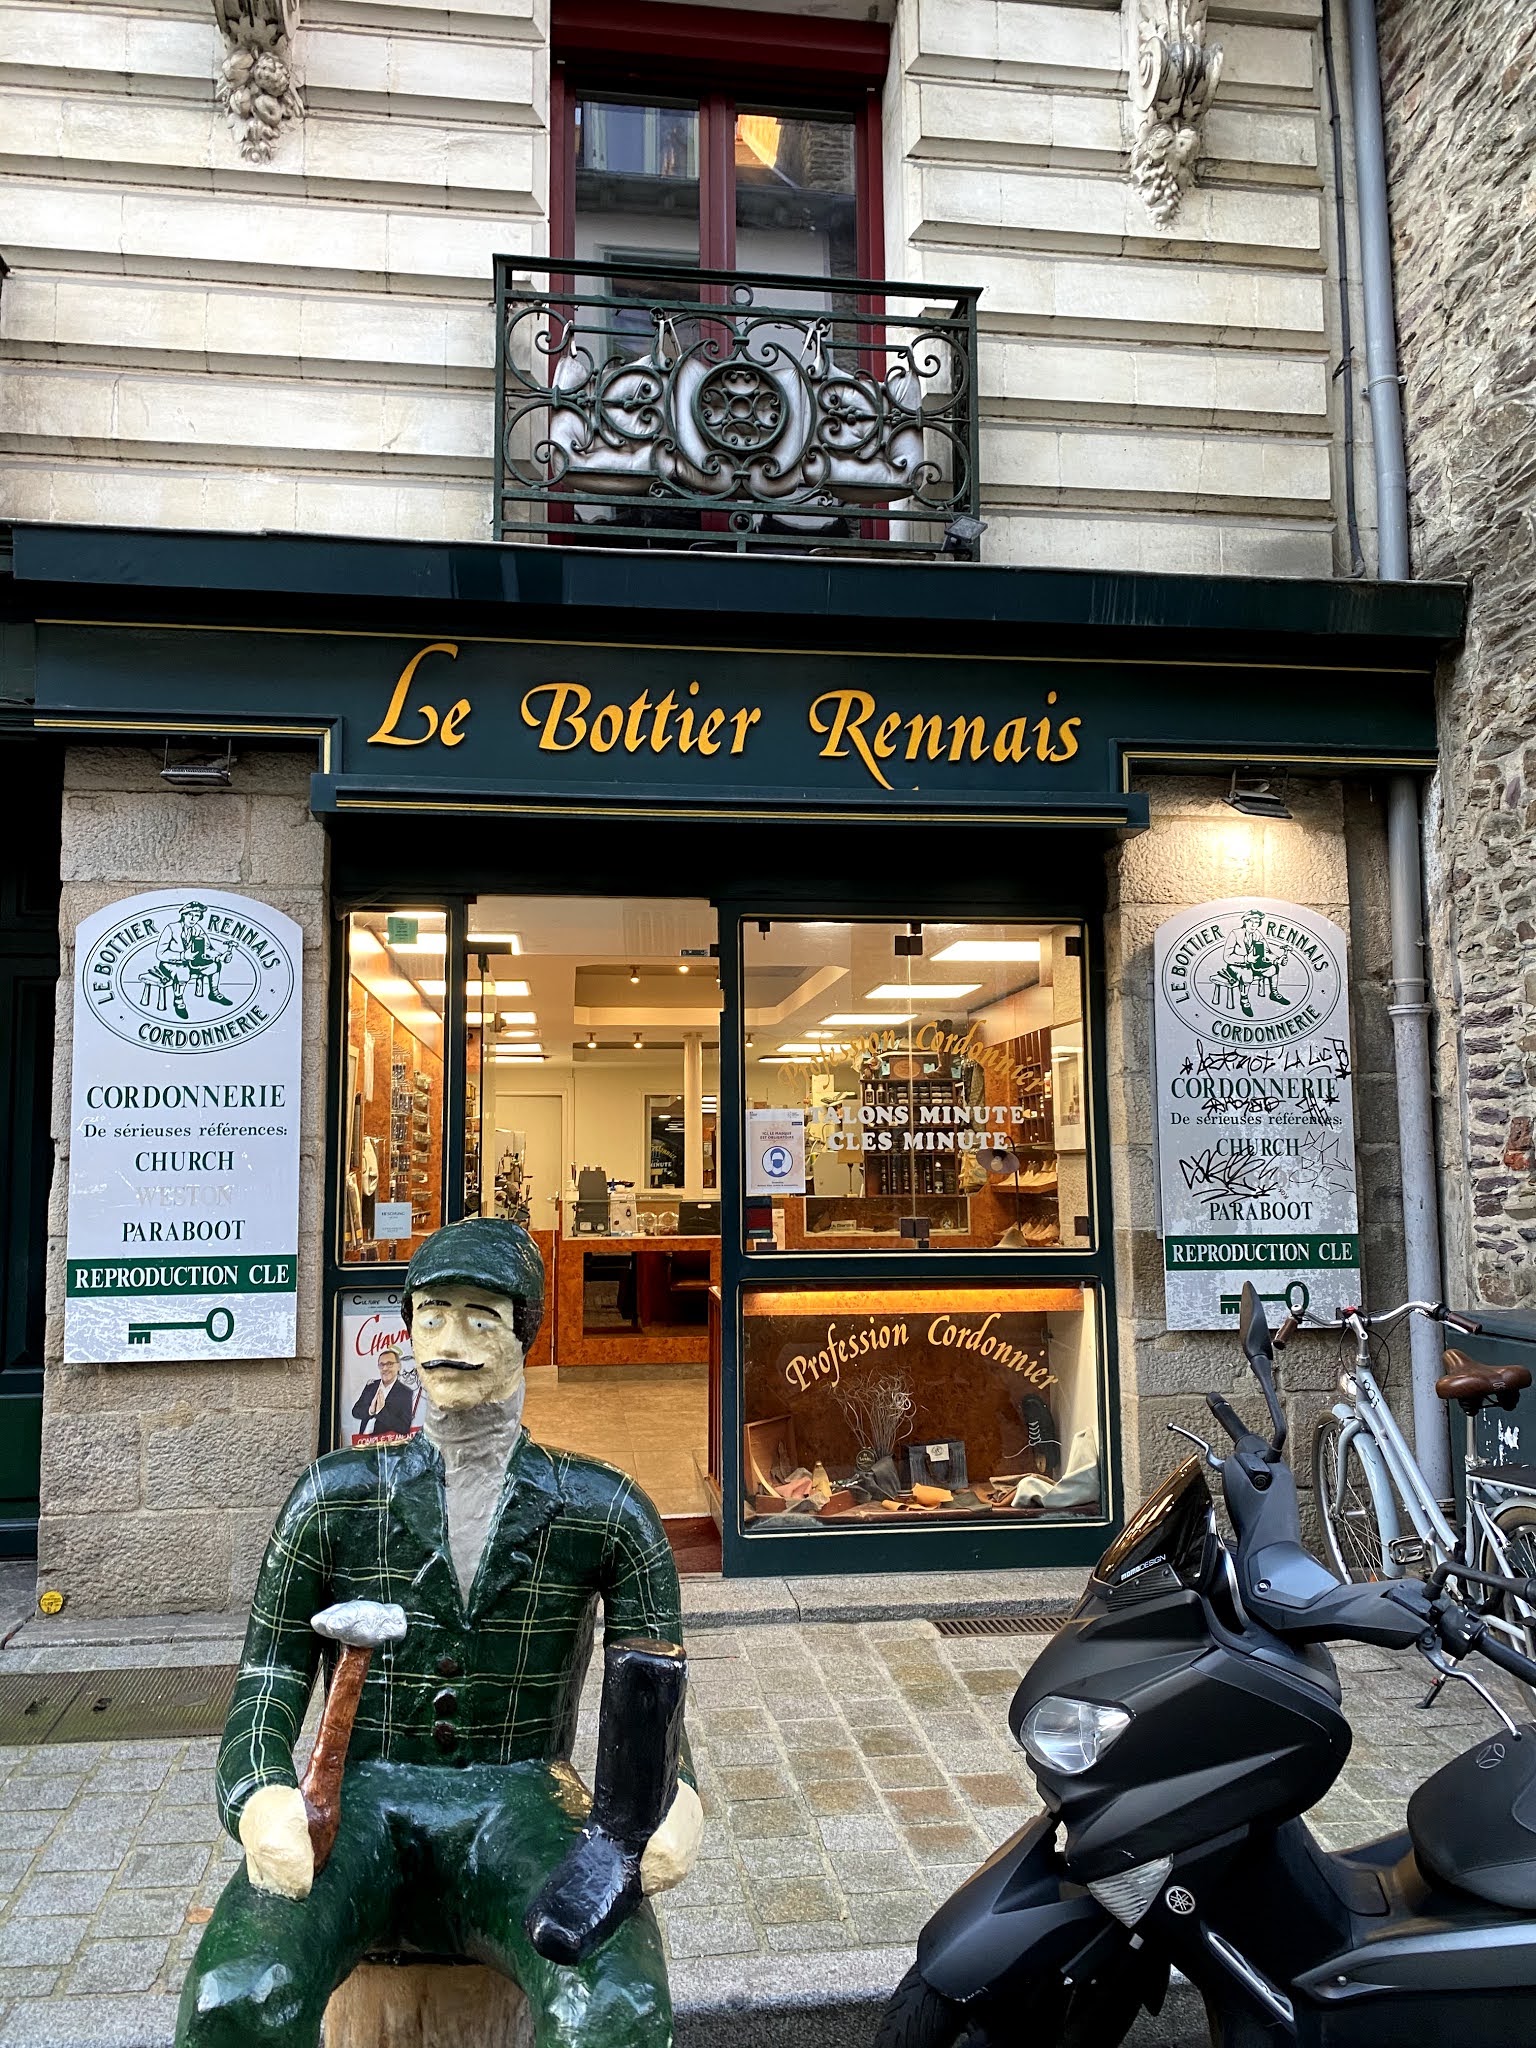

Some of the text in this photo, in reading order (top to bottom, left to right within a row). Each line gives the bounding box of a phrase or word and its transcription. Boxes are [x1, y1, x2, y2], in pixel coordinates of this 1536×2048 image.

[367, 643, 1082, 790] Le Bottier Rennais
[93, 914, 281, 1005] LE BOTTIER RENNAIS
[1171, 921, 1329, 1004] LE BOTTIER RENNAIS
[138, 1005, 269, 1049] CORDONNERIE
[1211, 1004, 1322, 1044] CORDONNERIE
[916, 1020, 1045, 1091] Cordonnier
[86, 1085, 286, 1109] CORDONNERIE
[1171, 1077, 1339, 1099] CORDONNERIE
[810, 1106, 1025, 1124] TALONS MINUTE
[1171, 1113, 1190, 1125] De
[1196, 1112, 1262, 1125] sérieuses
[83, 1124, 106, 1138] De
[114, 1123, 191, 1138] sérieuses
[200, 1122, 288, 1137] références:
[827, 1131, 1009, 1150] CLES MINUTE
[1217, 1138, 1300, 1157] CHURCH
[135, 1150, 235, 1171] CHURCH
[137, 1185, 233, 1207] WESTON
[1209, 1201, 1312, 1220] PARABOOT
[121, 1219, 246, 1242] PARABOOT
[1172, 1242, 1353, 1263] REPRODUCTION CLE
[74, 1264, 290, 1289] REPRODUCTION CLE
[785, 1312, 1059, 1392] Profession Cordonnier
